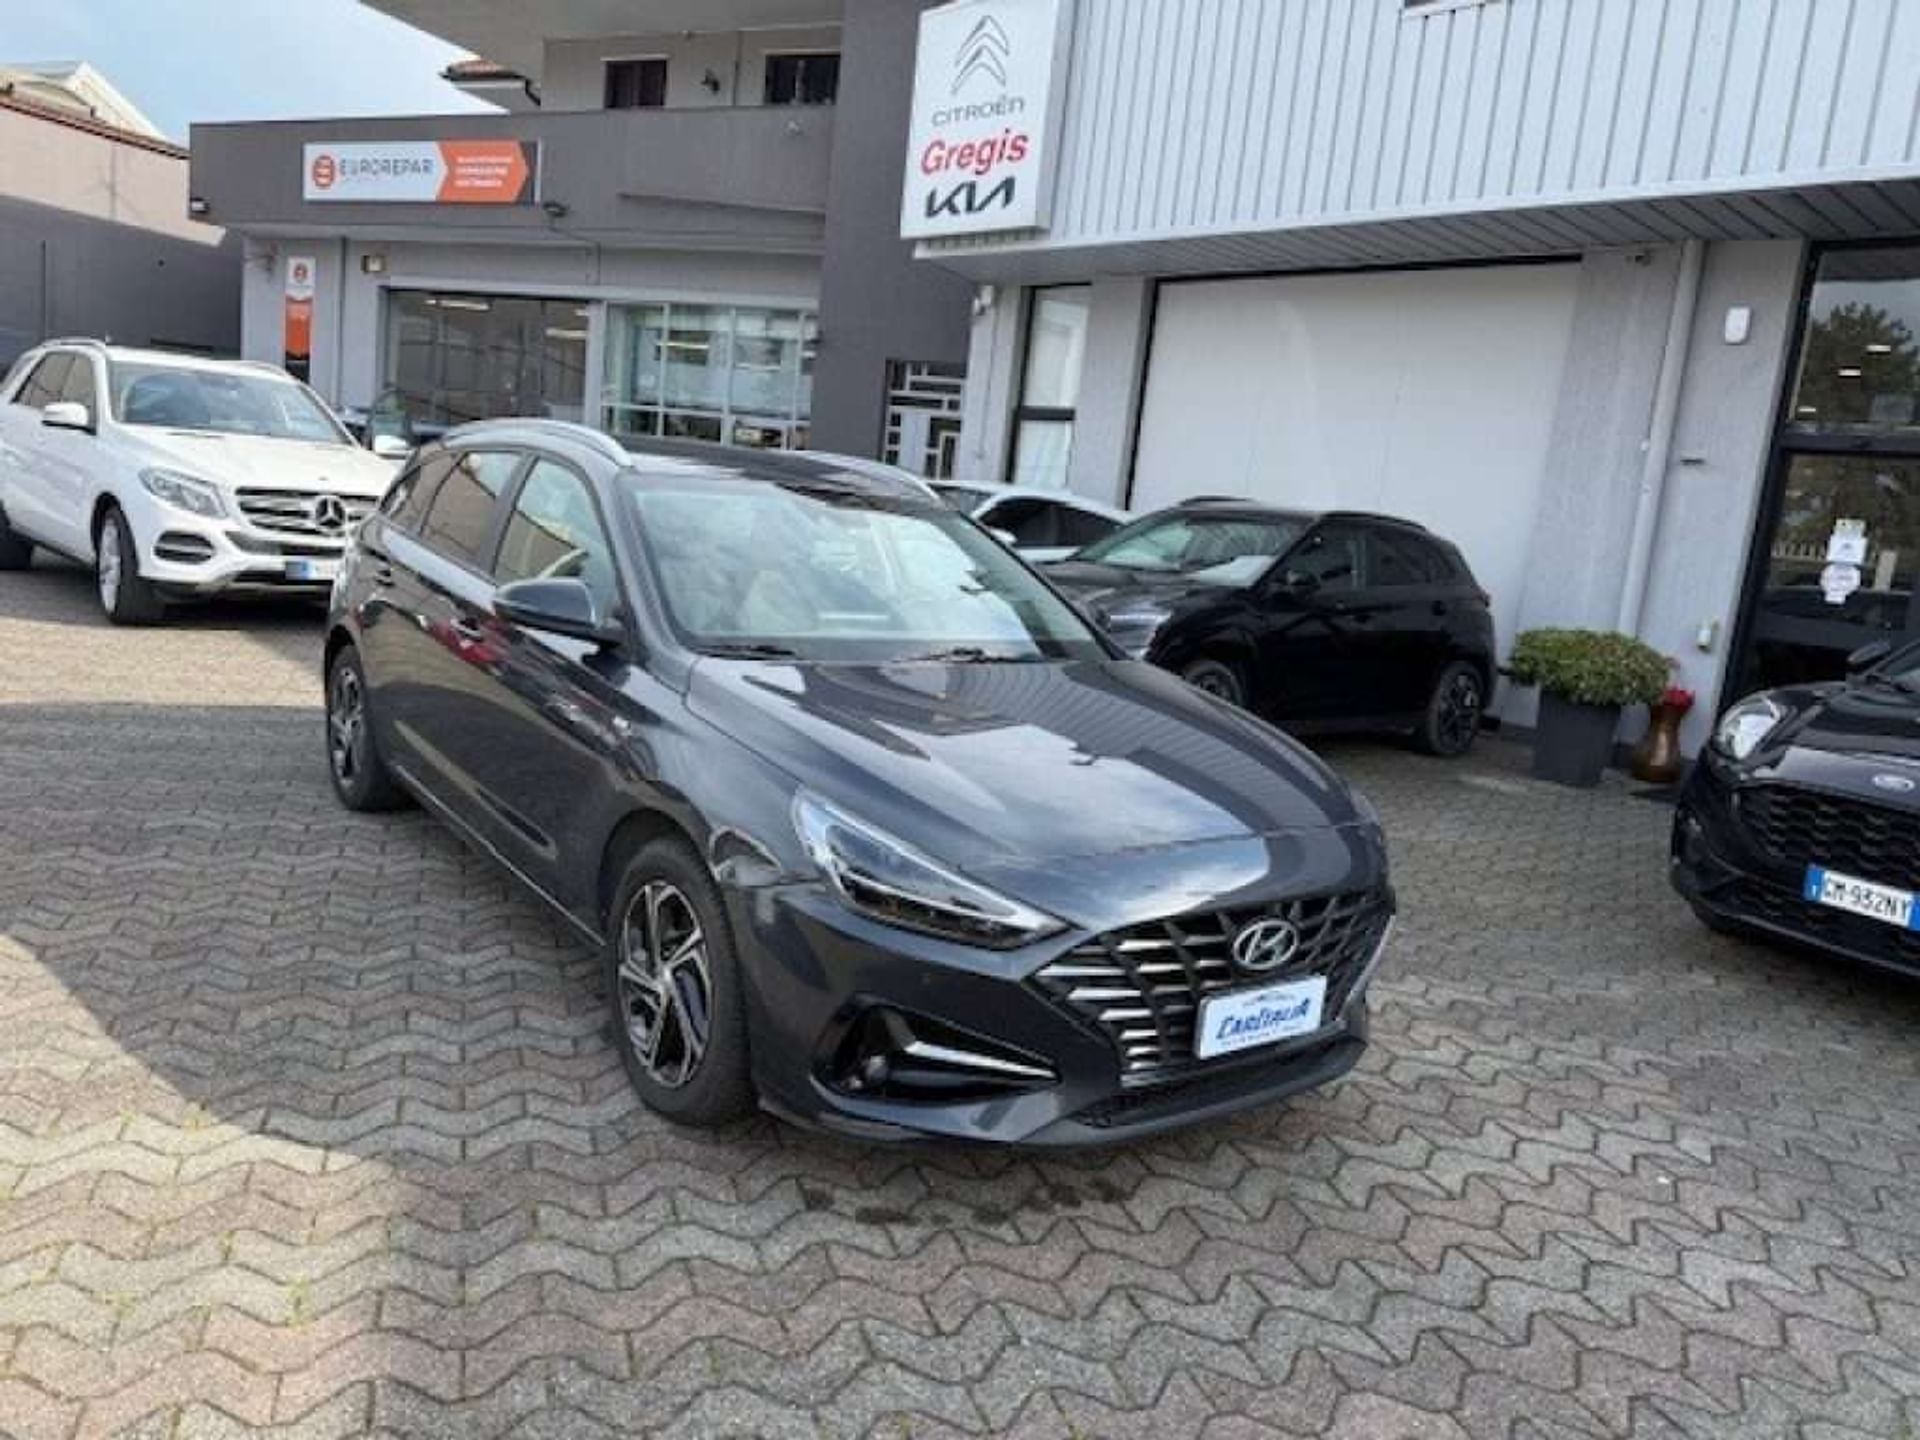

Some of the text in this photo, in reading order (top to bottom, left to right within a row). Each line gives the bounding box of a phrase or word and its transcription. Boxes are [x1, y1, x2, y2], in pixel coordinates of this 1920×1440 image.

[340, 157, 434, 176] EUROREPAR
[921, 128, 1029, 175] Gregis
[925, 176, 1015, 217] KIA
